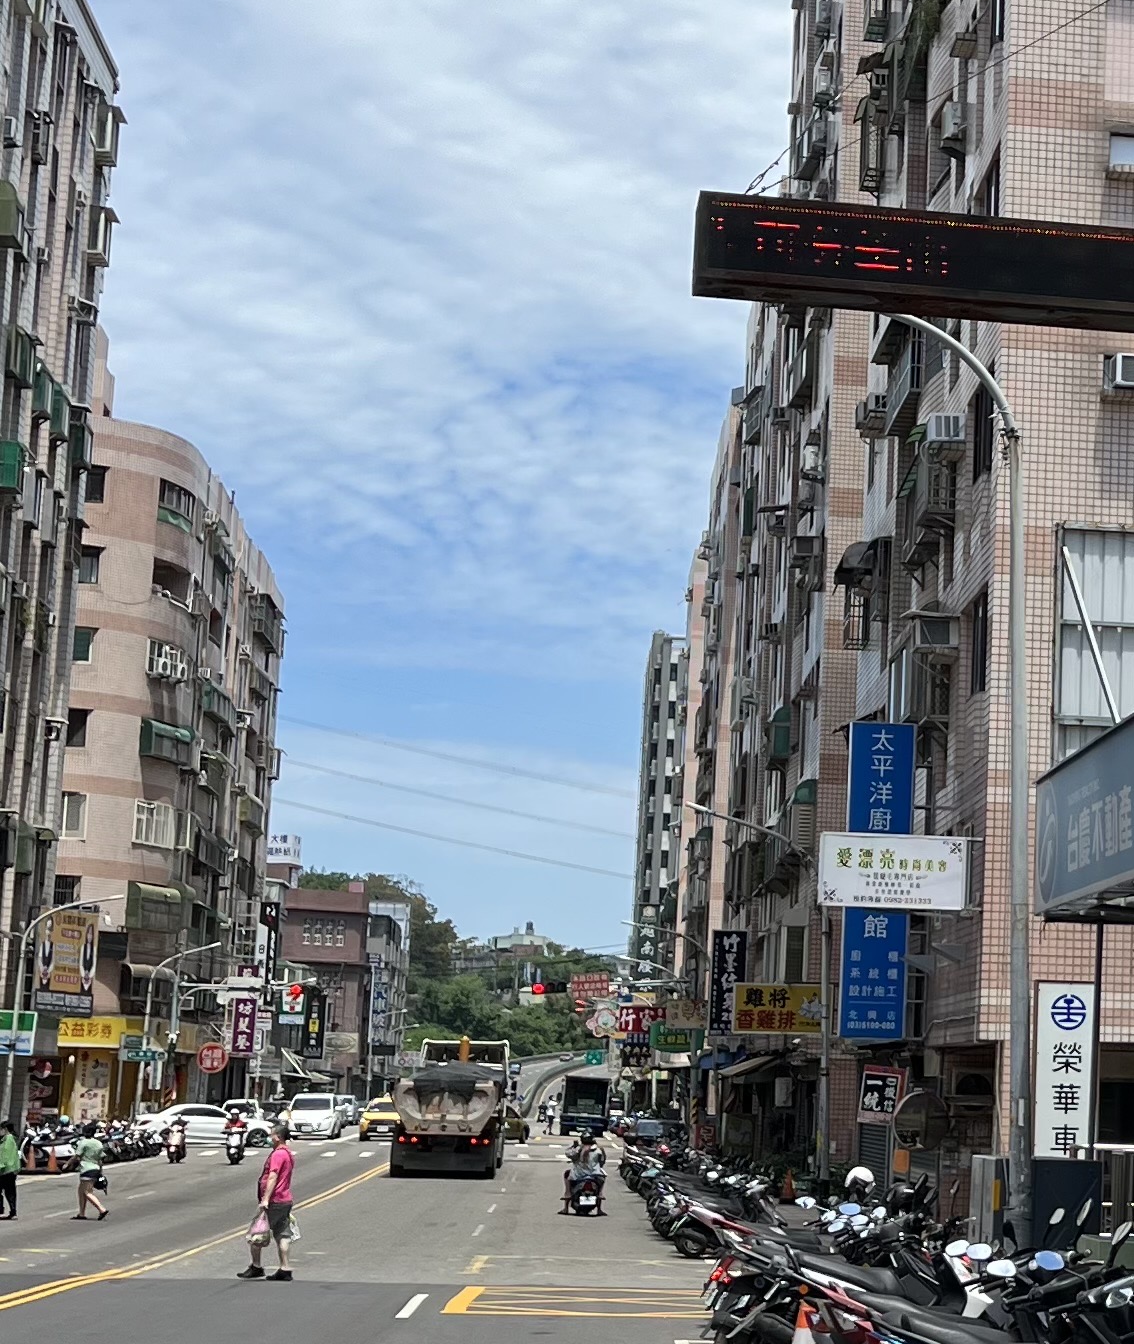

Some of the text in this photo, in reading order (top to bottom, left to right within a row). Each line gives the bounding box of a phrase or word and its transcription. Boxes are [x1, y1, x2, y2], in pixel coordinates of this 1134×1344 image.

[1066, 784, 1133, 873] 台慶不動產
[743, 987, 791, 1009] 雞將
[848, 984, 898, 998] 設計施工
[736, 1009, 797, 1030] 香雞排
